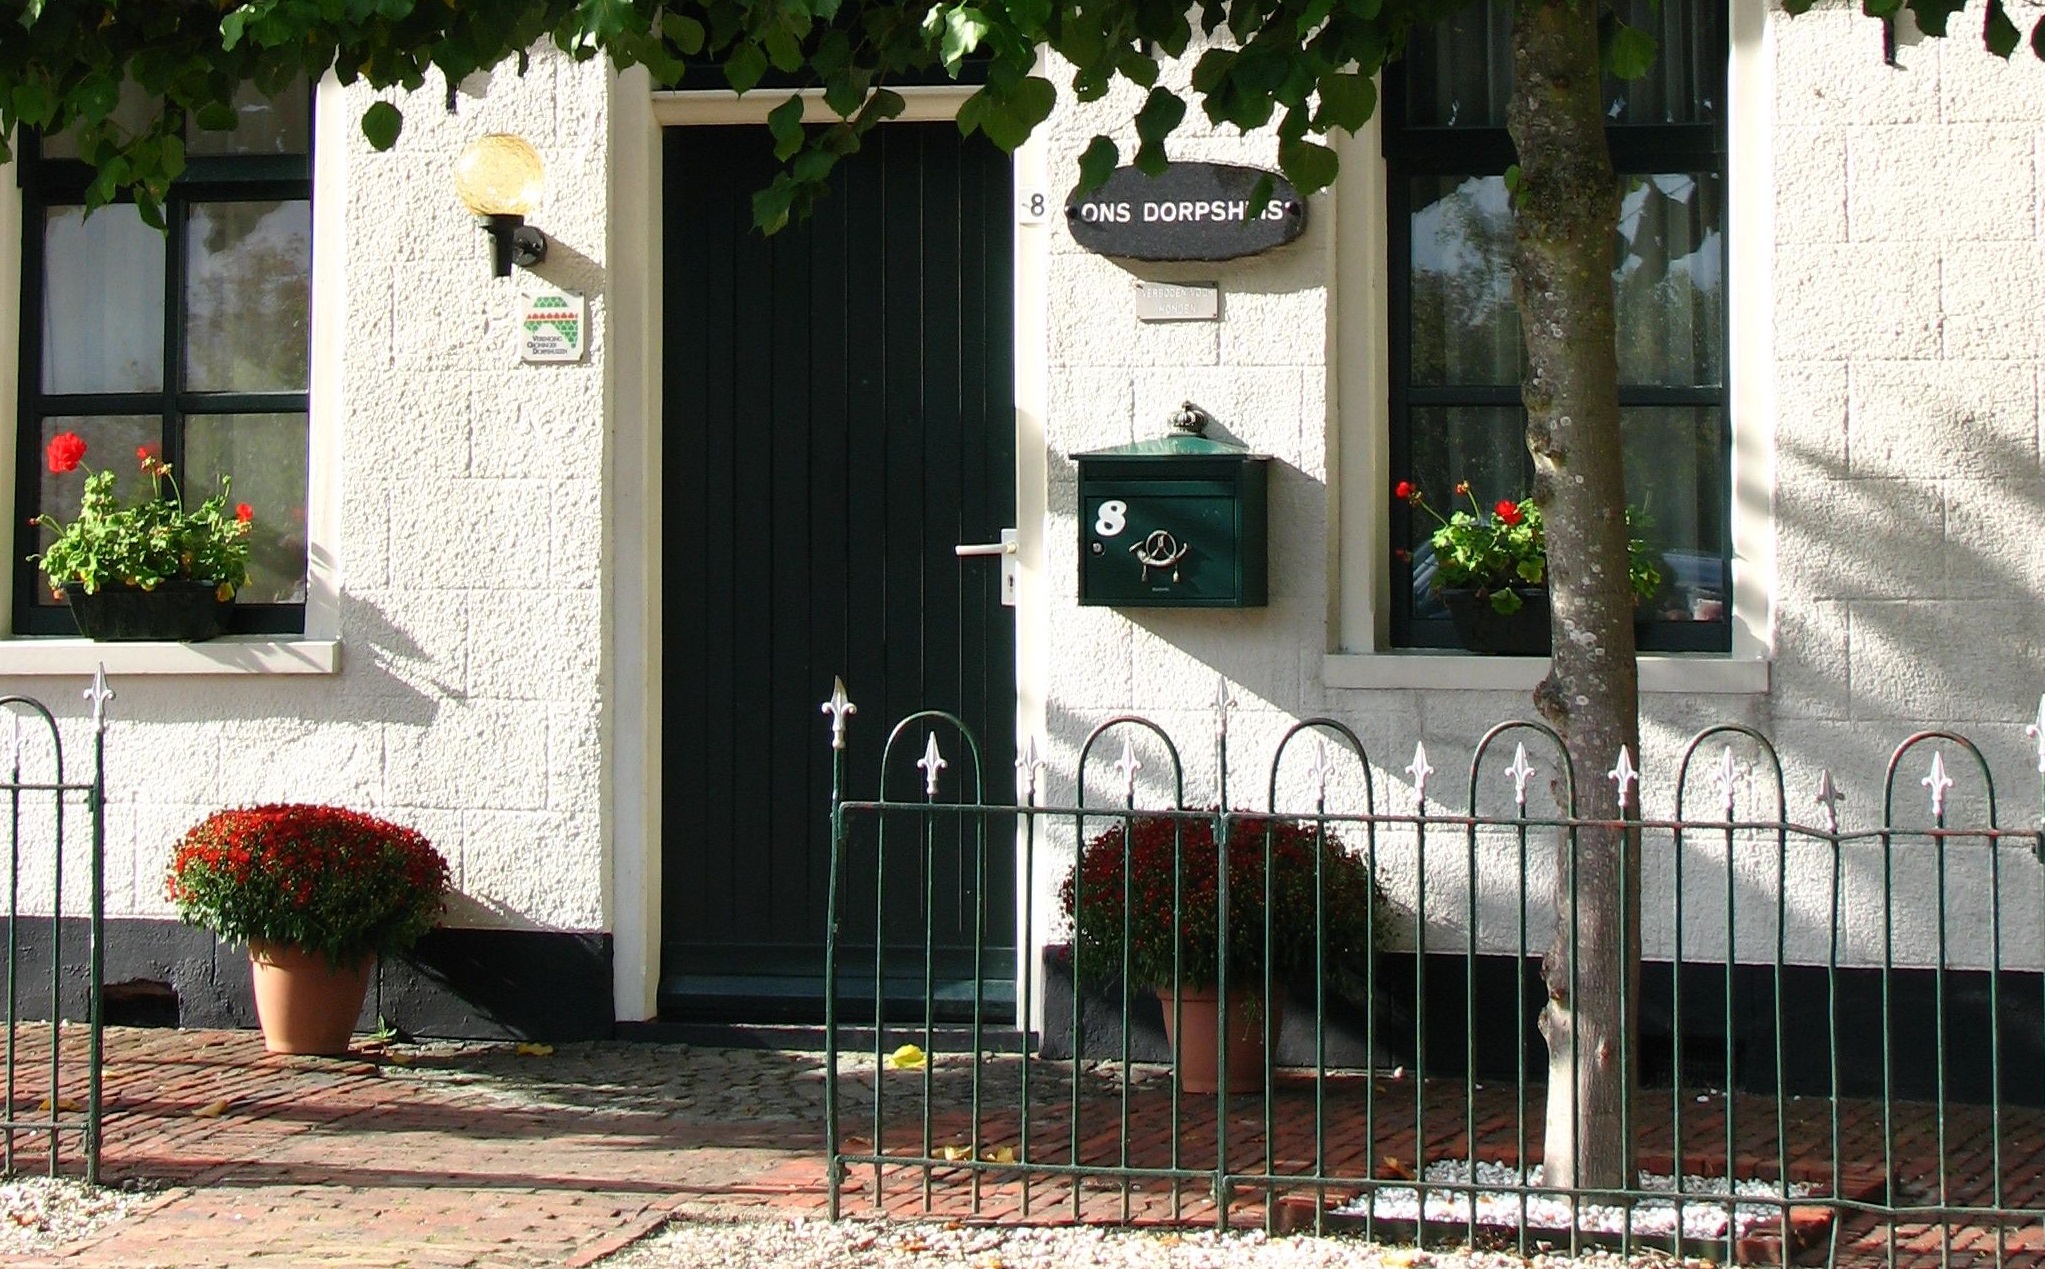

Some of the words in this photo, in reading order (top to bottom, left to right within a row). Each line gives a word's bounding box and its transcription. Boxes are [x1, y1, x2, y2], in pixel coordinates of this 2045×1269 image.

[1030, 192, 1045, 217] 8
[1081, 202, 1131, 223] ONS
[1143, 200, 1283, 223] DORPSHS
[1095, 499, 1128, 537] 8
